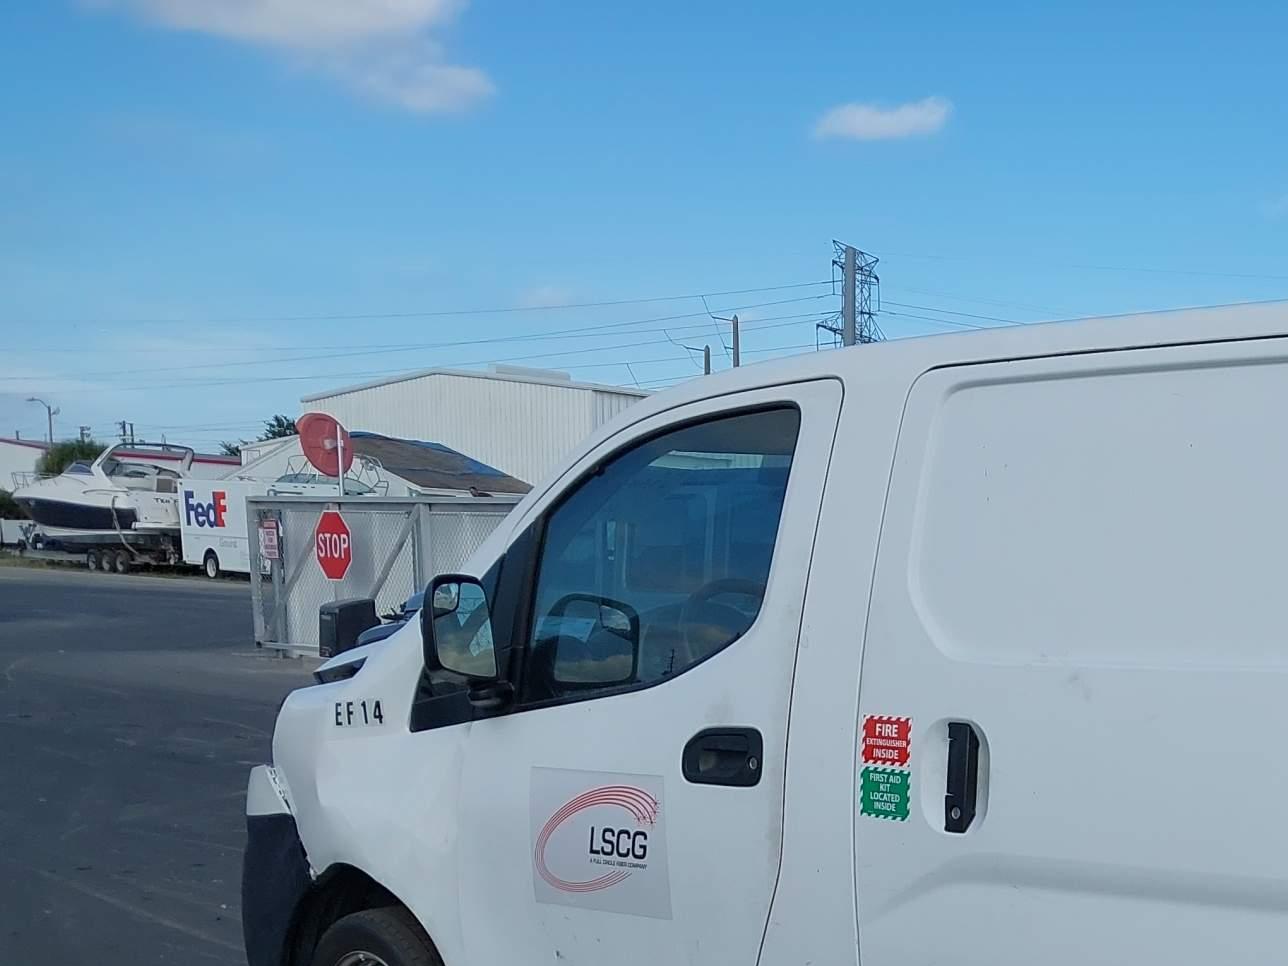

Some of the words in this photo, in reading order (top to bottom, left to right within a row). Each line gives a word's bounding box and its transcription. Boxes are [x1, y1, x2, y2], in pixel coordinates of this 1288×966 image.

[318, 533, 349, 559] STOP
[875, 723, 899, 737] FIRE
[866, 737, 907, 748] EXTINGUISHER
[873, 748, 899, 760] INSIDE
[869, 772, 888, 783] FIRST
[888, 774, 902, 784] AID
[879, 783, 891, 793] KIT
[870, 791, 901, 803] LOCATED
[873, 801, 897, 812] INSIDE
[589, 826, 648, 860] LSCG
